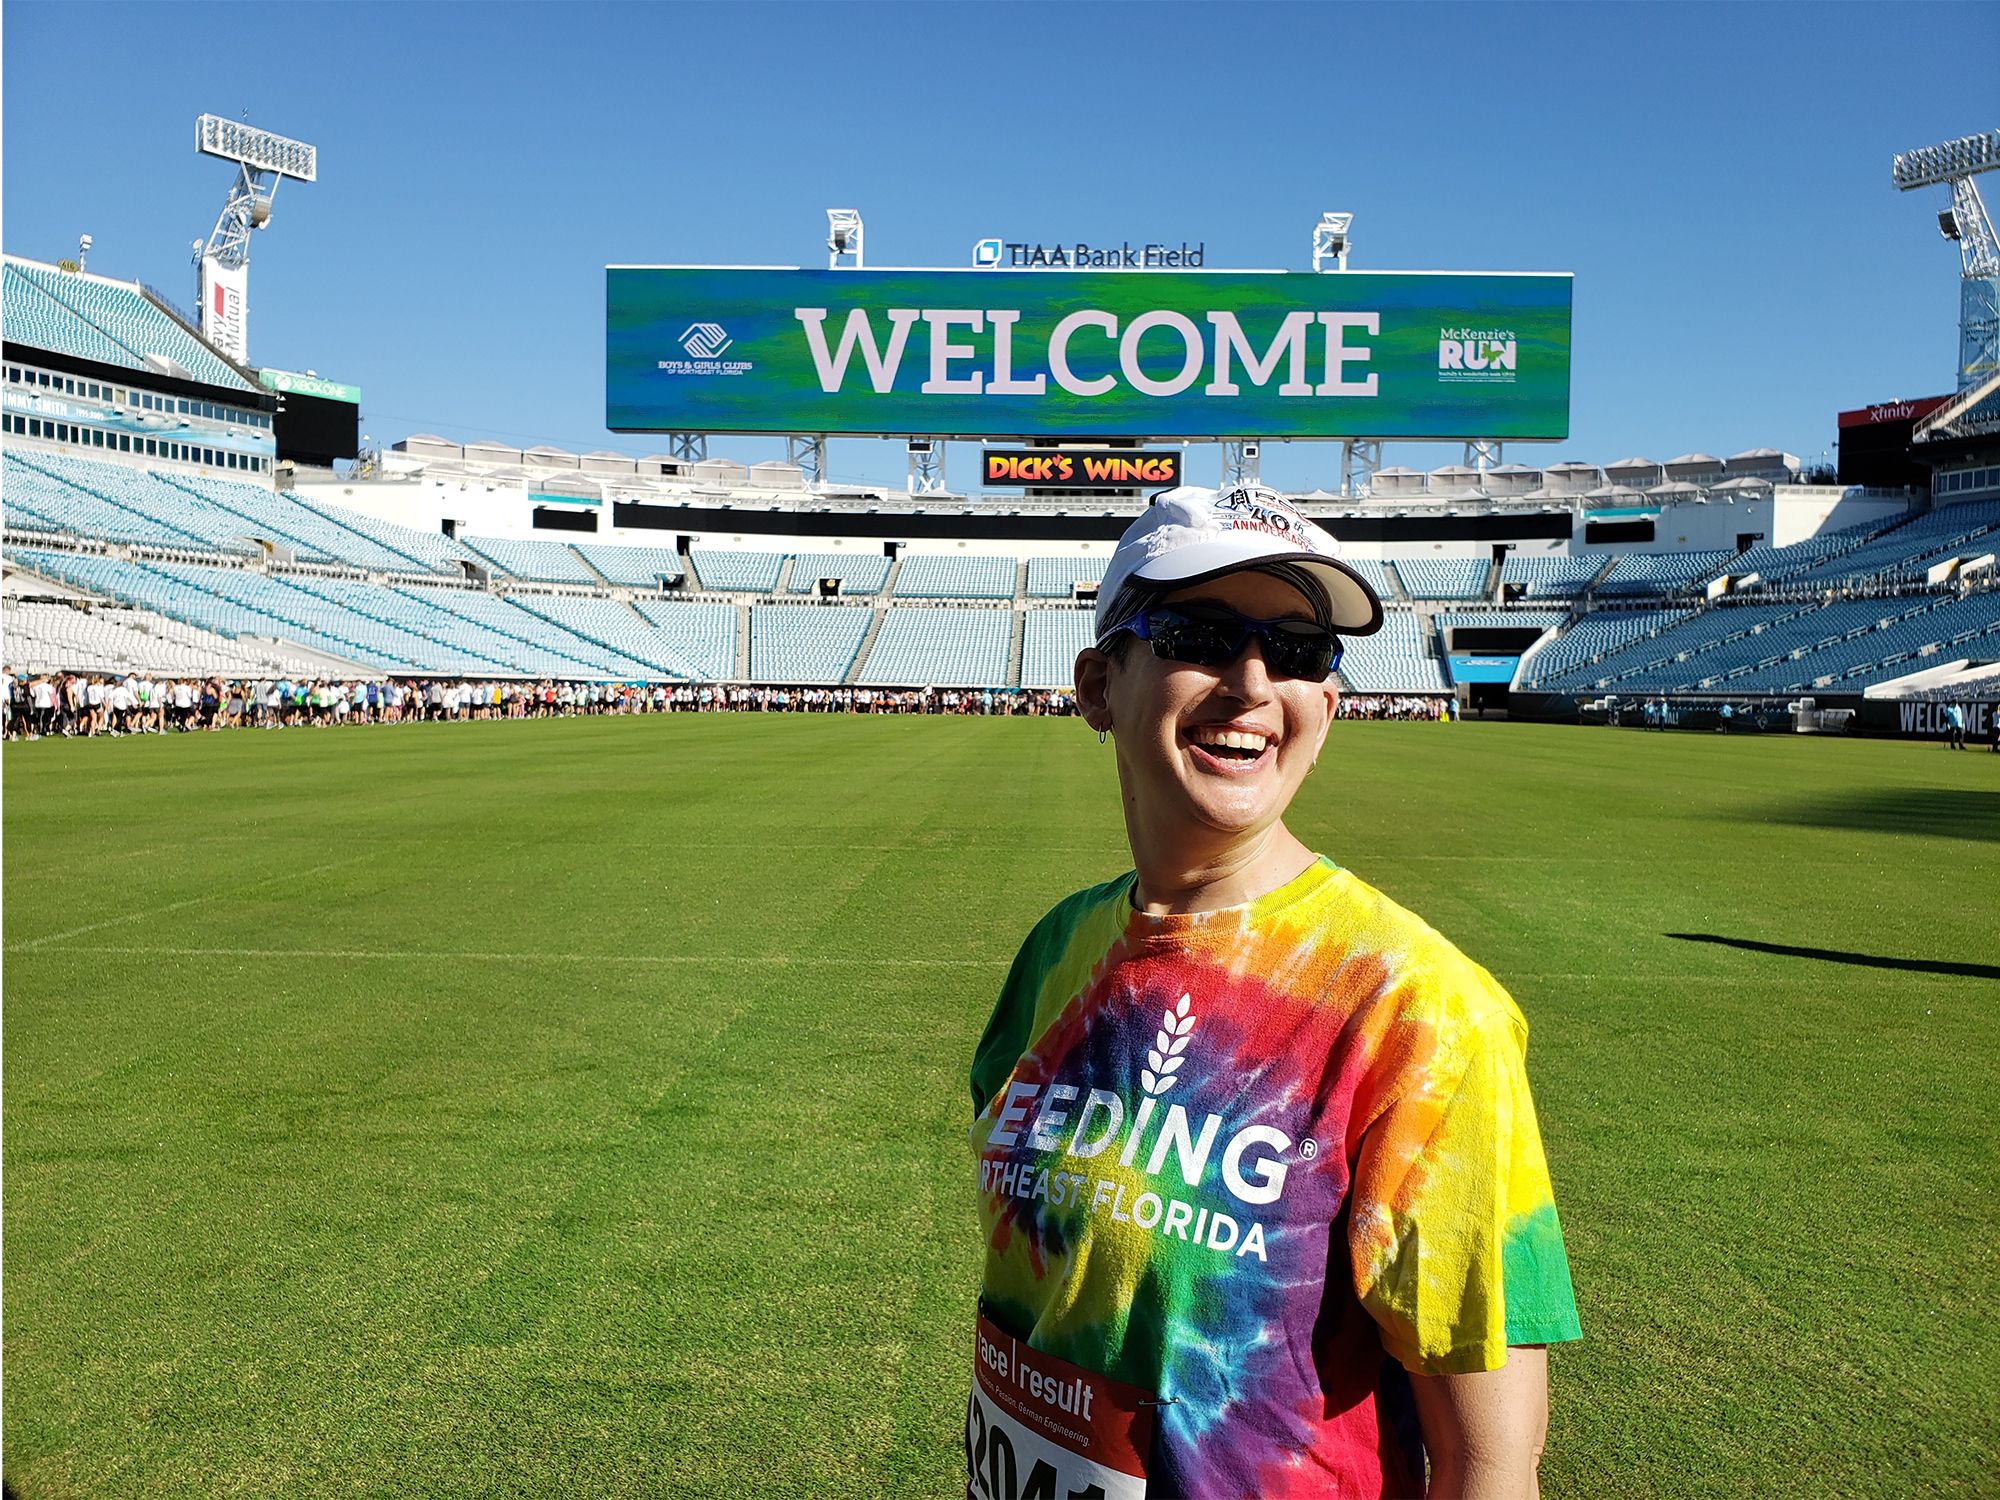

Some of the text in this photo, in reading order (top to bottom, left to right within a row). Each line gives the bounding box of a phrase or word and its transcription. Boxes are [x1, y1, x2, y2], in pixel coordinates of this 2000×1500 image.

[1005, 241, 1204, 268] TIAA Bank Field
[213, 316, 227, 348] avy
[225, 287, 240, 351] Mutual
[1440, 328, 1516, 340] McKenzie's
[658, 361, 753, 370] BOYS & GIRLS CLUBS
[794, 307, 1380, 396] WELCOME
[1438, 340, 1517, 370] RUN
[3, 391, 33, 409] IMMY
[35, 398, 68, 416] SMITH
[292, 378, 347, 398] XBOX ONE
[1870, 404, 1915, 422] xfinity
[988, 454, 1174, 482] DICK'S WINGS
[1232, 519, 1310, 552] ANNIVERSARY
[1900, 703, 1988, 734] WELCME
[978, 1081, 1318, 1205] EEDING®
[979, 1159, 1268, 1263] RTHEAST FLORIDA
[1020, 1362, 1094, 1422] result
[1018, 1401, 1043, 1424] German
[1044, 1416, 1091, 1448] Engineering.
[972, 1393, 1107, 1500] 20
